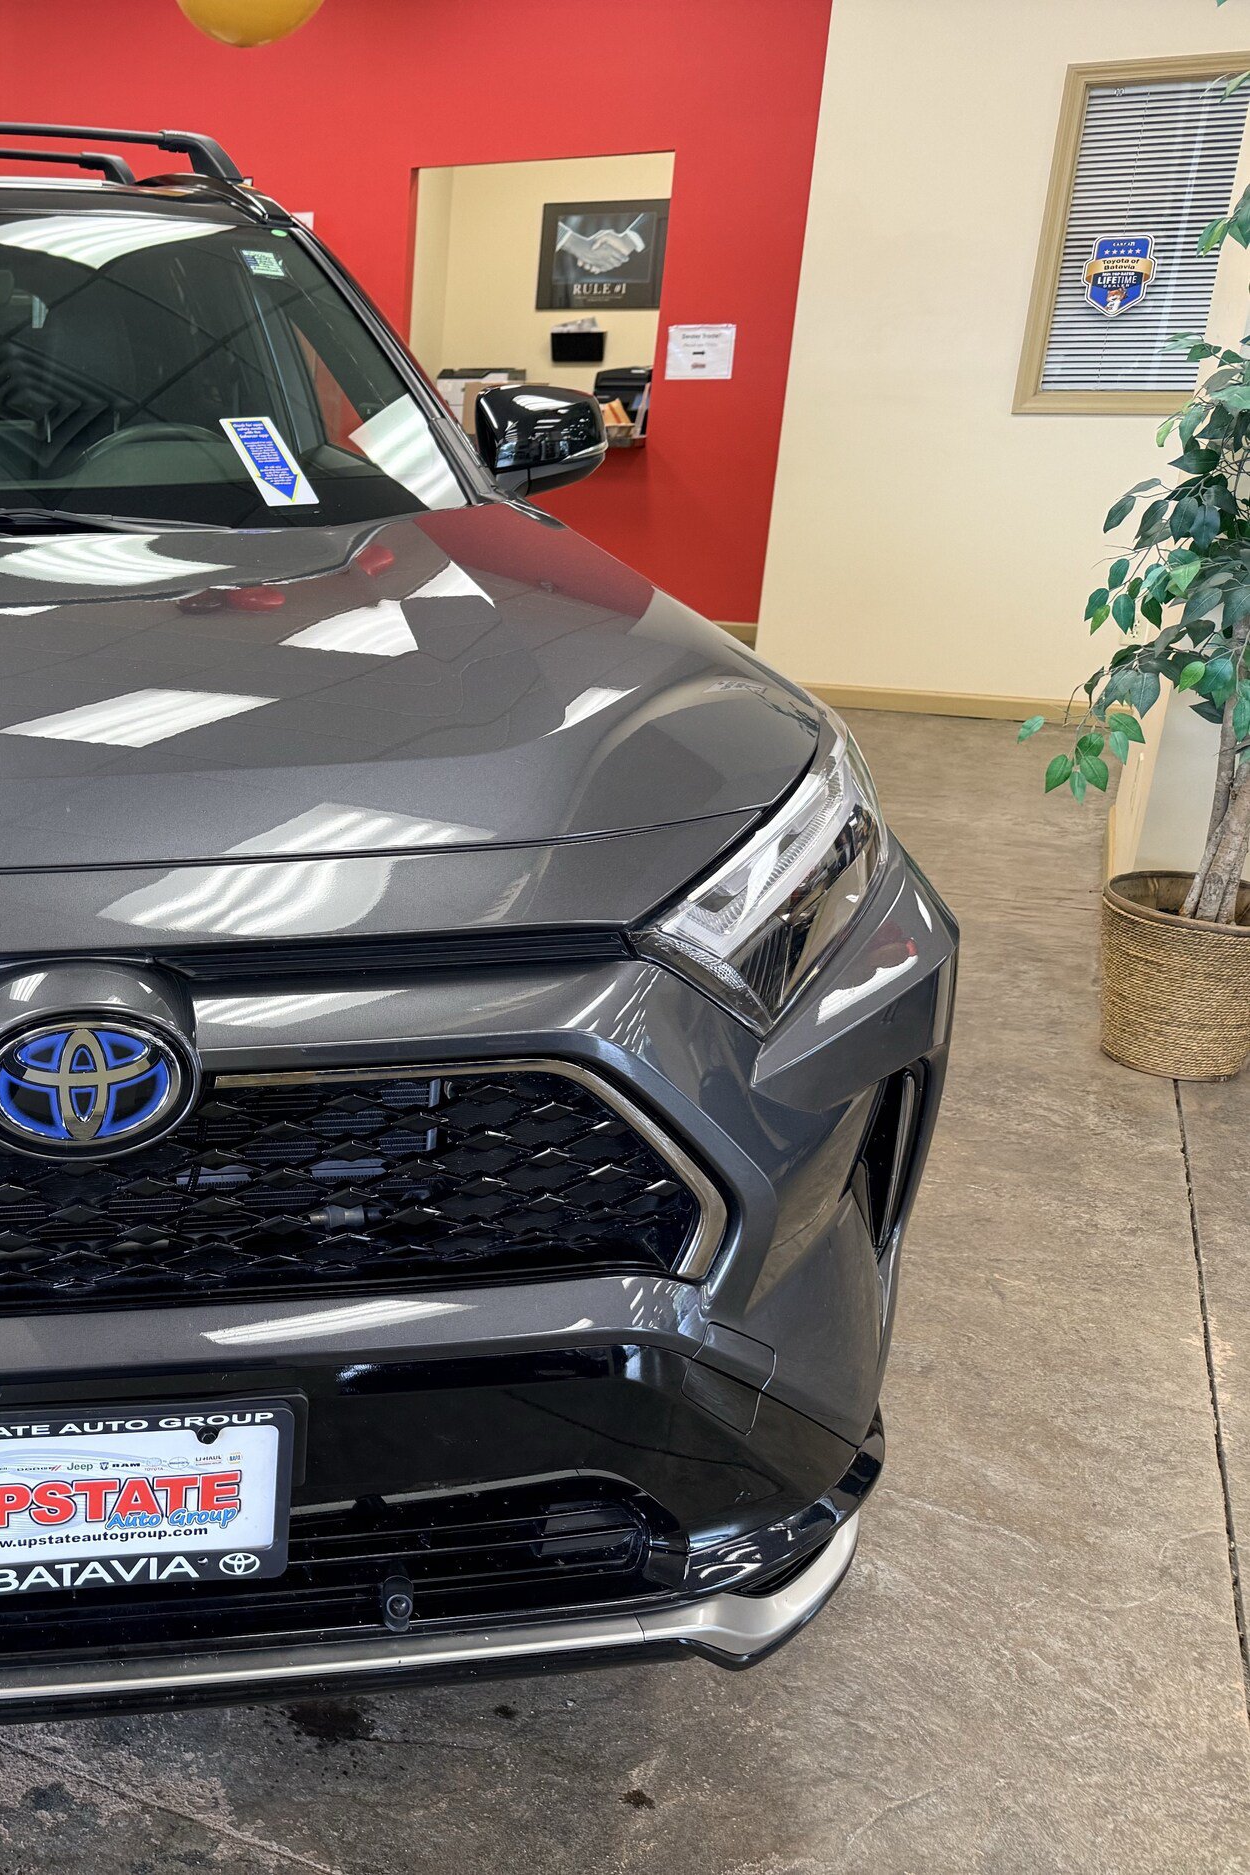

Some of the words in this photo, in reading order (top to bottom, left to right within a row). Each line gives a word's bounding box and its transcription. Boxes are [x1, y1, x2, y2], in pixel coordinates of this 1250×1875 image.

[1097, 276, 1137, 284] LIFETIME
[572, 283, 612, 295] RULE
[613, 283, 627, 295] #1
[58, 1418, 149, 1435] AUTO
[158, 1411, 275, 1428] GROUP
[66, 1461, 94, 1472] Jeep
[105, 1509, 160, 1530] Auto
[169, 1507, 239, 1529] Group
